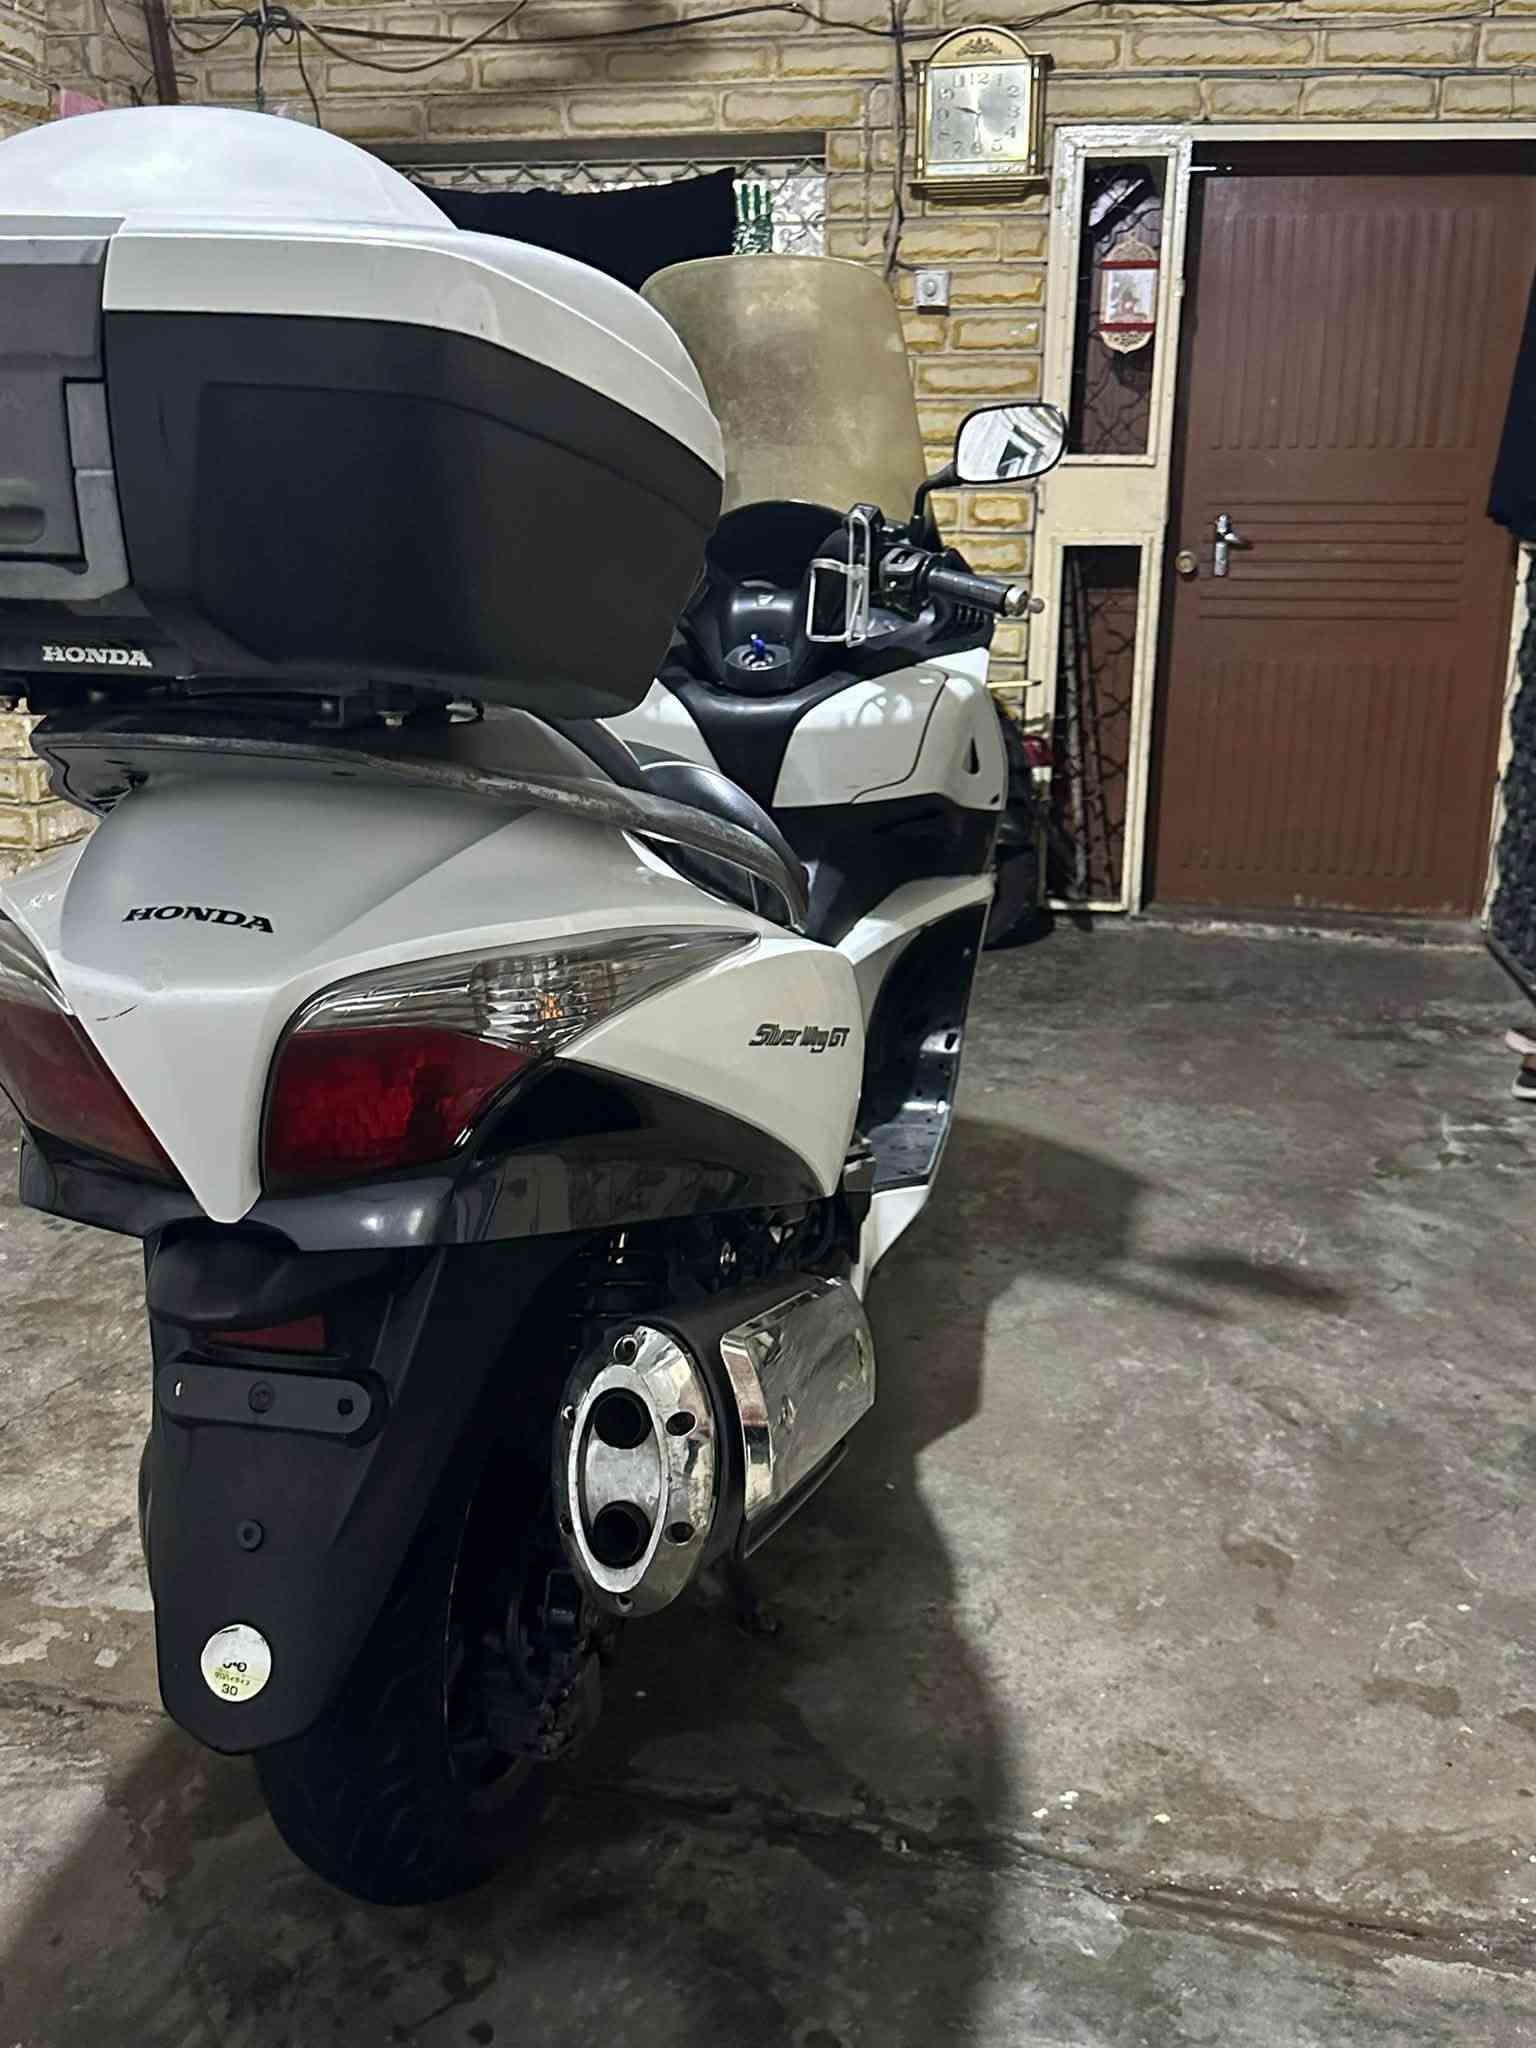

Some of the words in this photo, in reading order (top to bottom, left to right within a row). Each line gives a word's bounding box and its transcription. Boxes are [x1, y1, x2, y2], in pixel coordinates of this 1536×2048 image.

[970, 72, 990, 86] 12
[1007, 84, 1019, 98] 2
[1007, 104, 1020, 119] 3
[1004, 125, 1016, 139] 4
[991, 138, 1003, 153] 5
[42, 645, 153, 668] HONDA
[122, 906, 274, 934] HONDA
[828, 1026, 850, 1048] GT
[221, 1682, 239, 1697] 30
